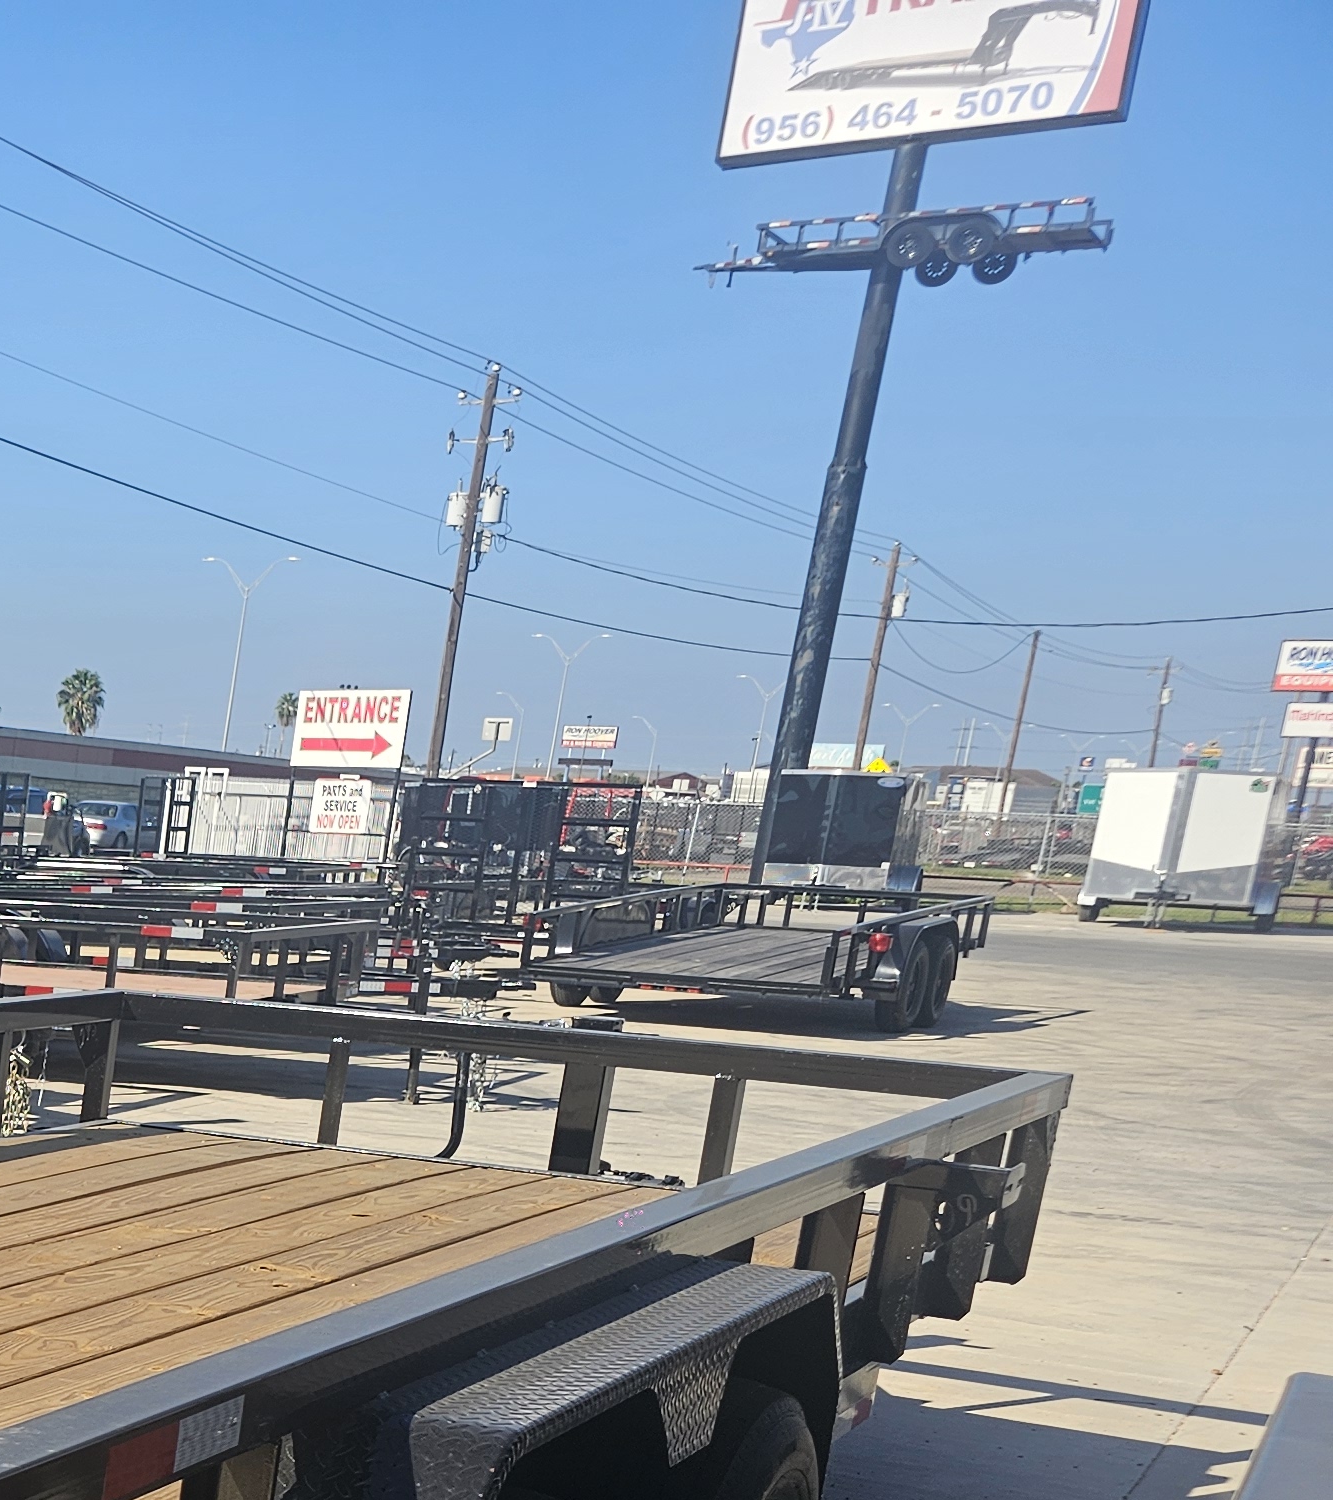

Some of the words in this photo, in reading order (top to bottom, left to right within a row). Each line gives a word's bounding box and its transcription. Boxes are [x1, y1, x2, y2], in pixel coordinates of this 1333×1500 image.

[742, 105, 834, 149] (956)
[847, 98, 918, 132] 464
[954, 81, 1054, 120] 5070
[303, 696, 402, 724] ENTRANCE
[322, 785, 347, 797] PARTS
[323, 800, 357, 812] SERVICE
[316, 814, 336, 829] NOW
[338, 814, 361, 830] OPEN
